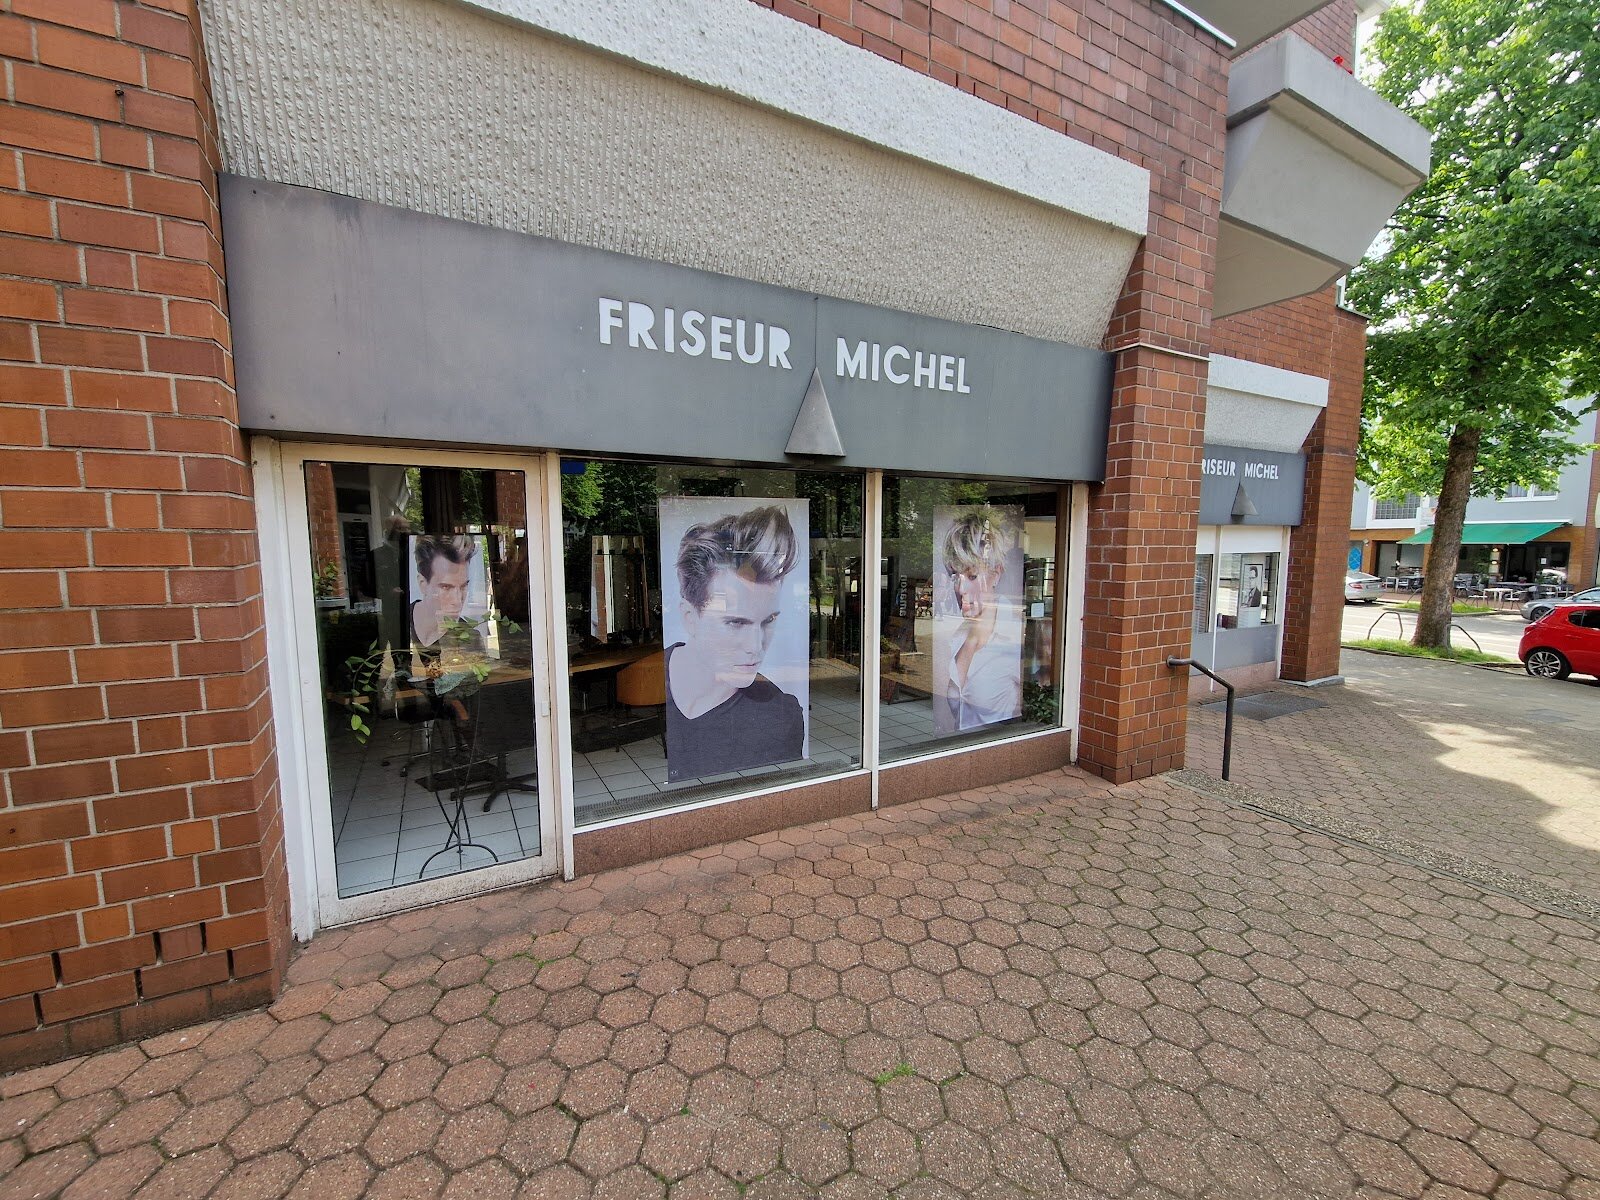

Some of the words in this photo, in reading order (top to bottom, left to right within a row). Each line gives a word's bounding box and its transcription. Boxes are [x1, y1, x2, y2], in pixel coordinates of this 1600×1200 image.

[598, 297, 793, 370] FRISEUR
[836, 337, 971, 394] MICHEL
[1201, 458, 1236, 476] RISEUR
[1244, 462, 1279, 480] MICHEL
